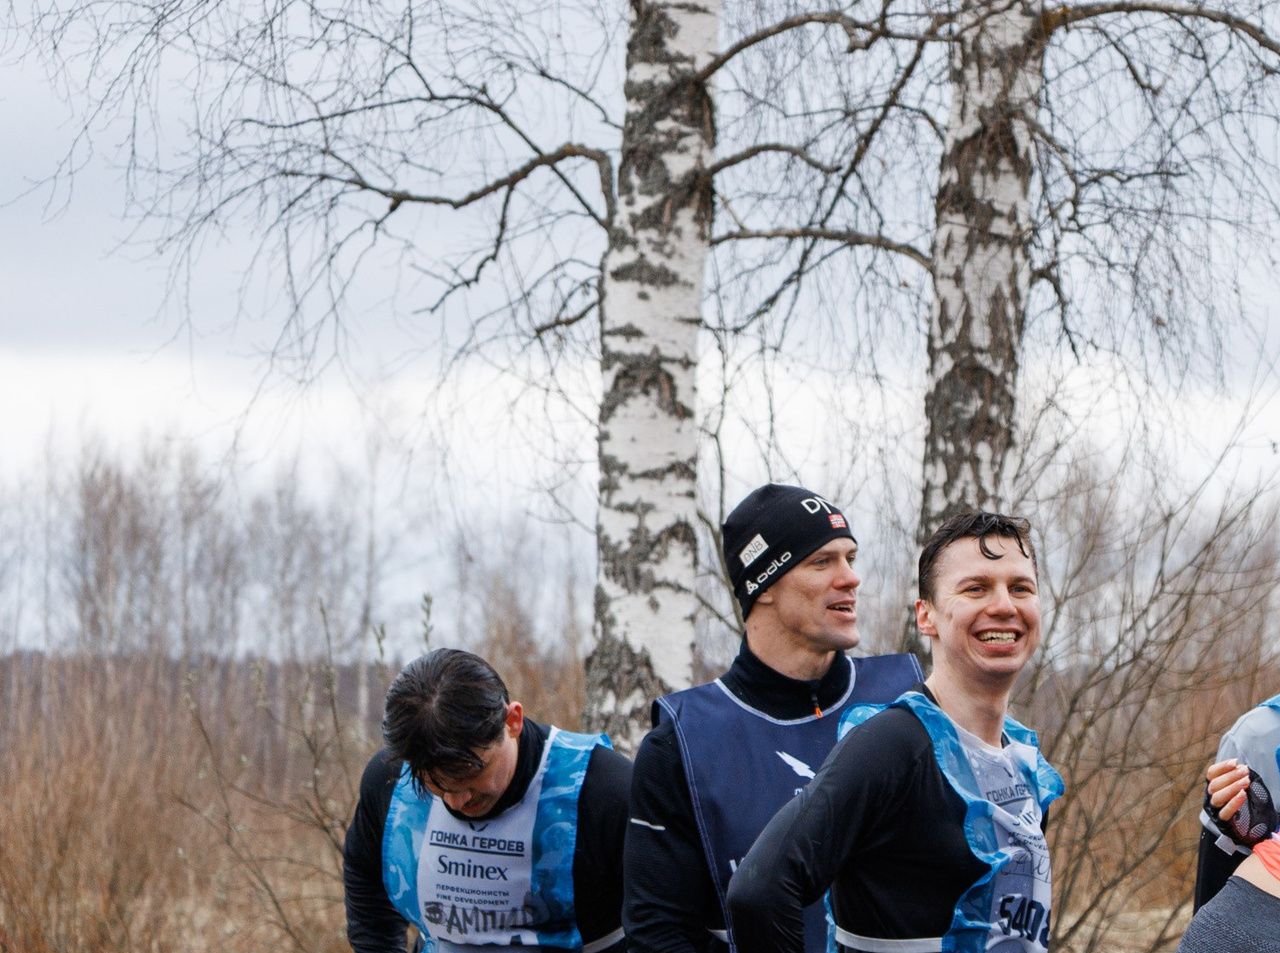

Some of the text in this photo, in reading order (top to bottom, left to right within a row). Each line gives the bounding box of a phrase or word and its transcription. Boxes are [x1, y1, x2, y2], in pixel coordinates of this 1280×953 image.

[986, 786, 1015, 802] ГОНКА
[430, 830, 525, 852] ГОНКА ГЕРОЕВ
[437, 855, 508, 881] Sminex
[436, 884, 510, 897] ПЕРФЕКЦИОНИСТЫ
[455, 896, 510, 905] DEVELOPMENT
